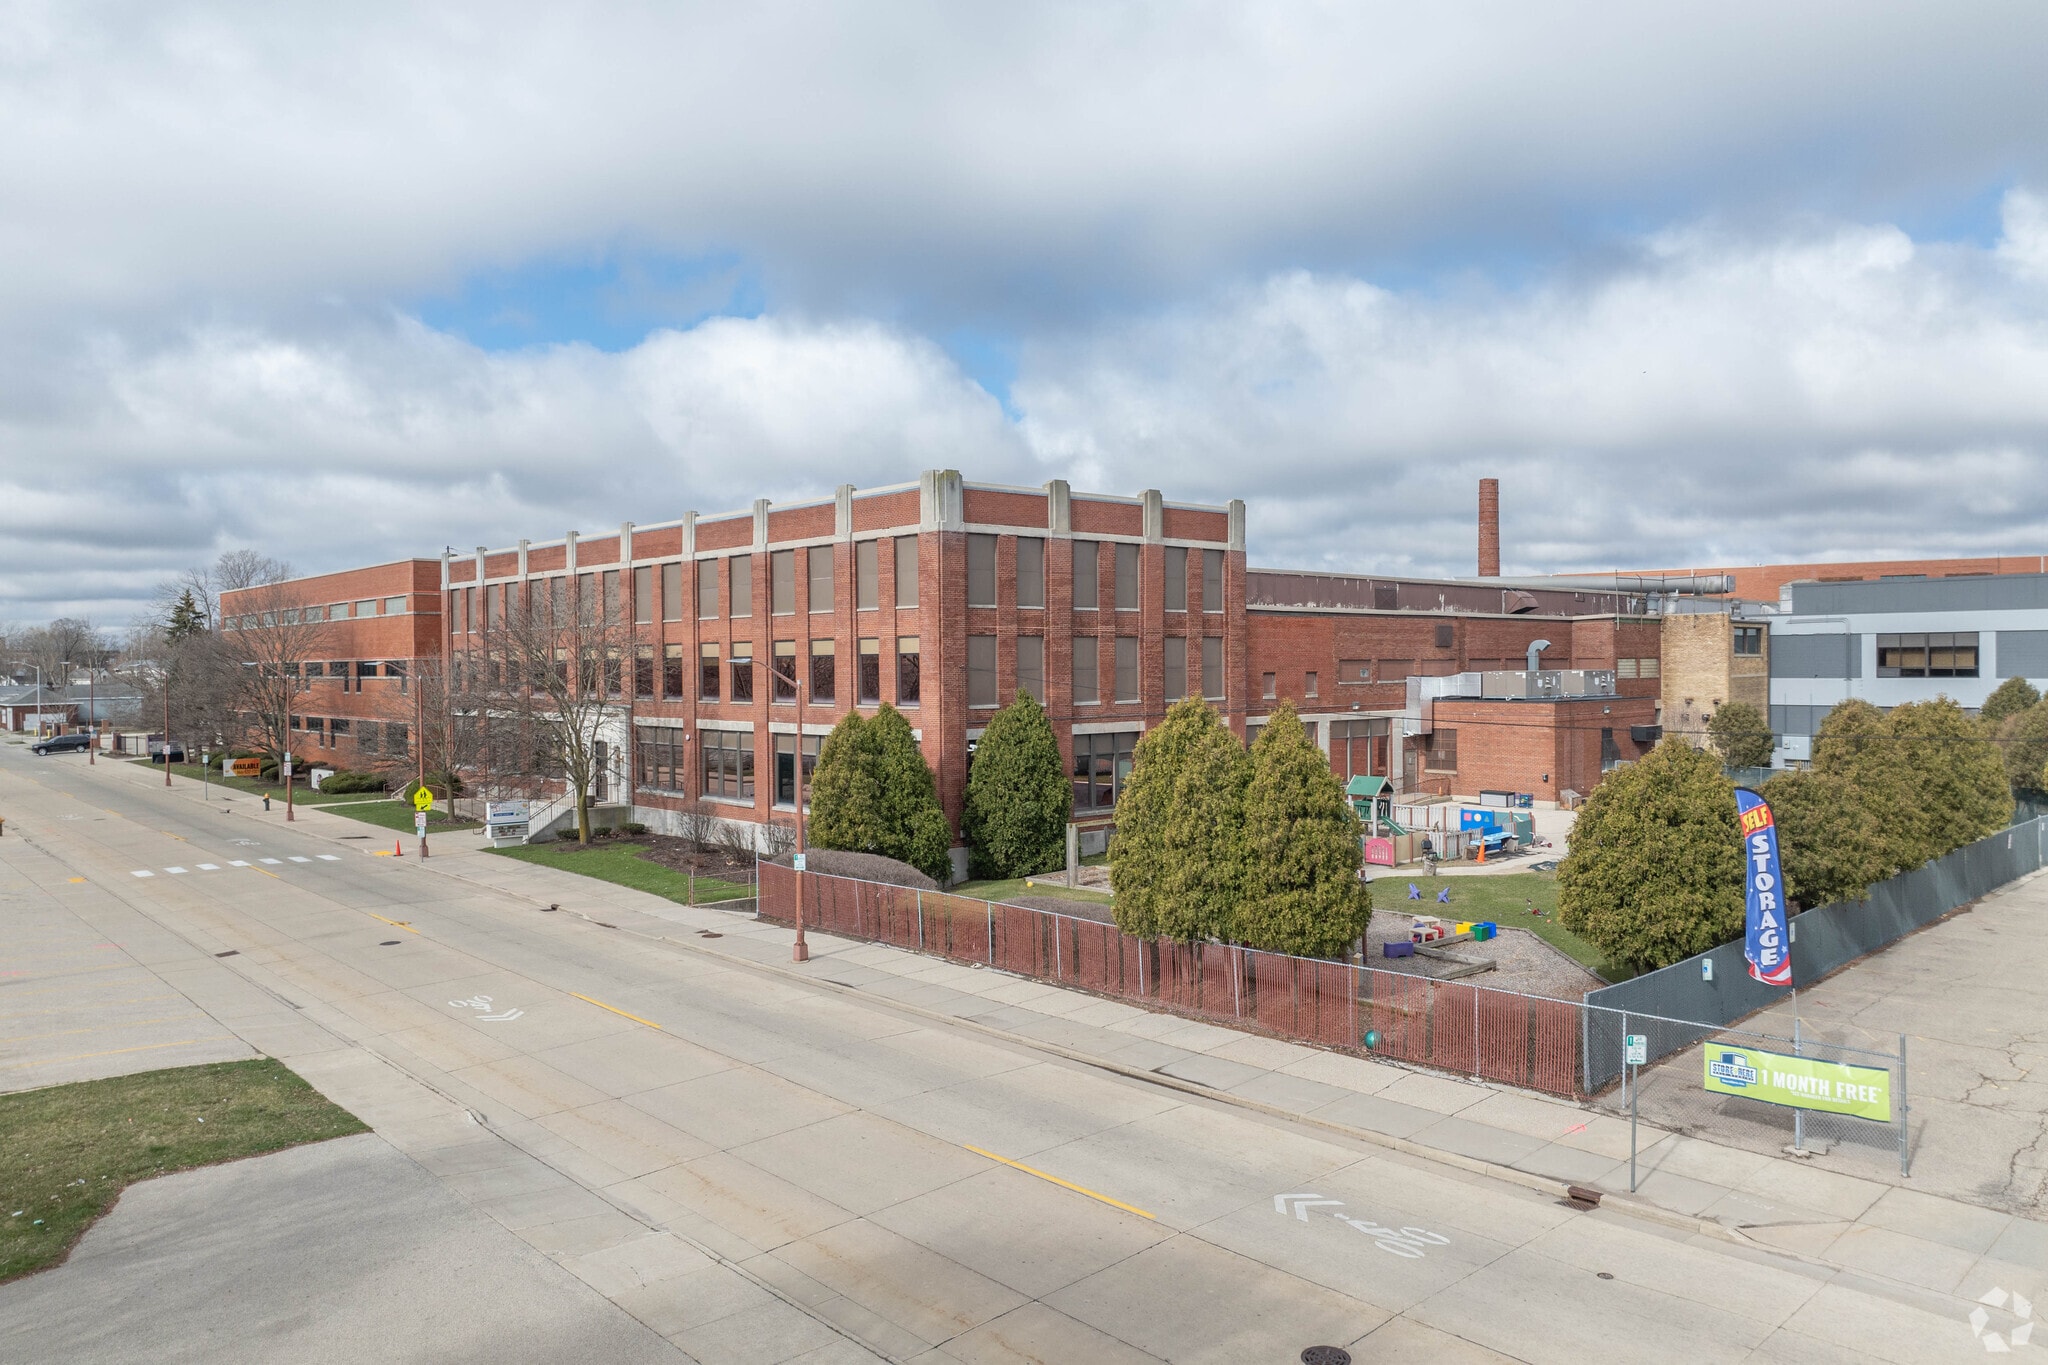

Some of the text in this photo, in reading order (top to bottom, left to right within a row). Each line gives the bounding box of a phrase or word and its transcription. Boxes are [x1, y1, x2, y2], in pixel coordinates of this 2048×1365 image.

[1743, 806, 1768, 832] SELF
[1752, 834, 1779, 966] STORAGE
[1712, 1063, 1734, 1074] STORE
[1737, 1067, 1754, 1078] HERE
[1761, 1069, 1768, 1085] 1
[1773, 1071, 1830, 1096] MONTH
